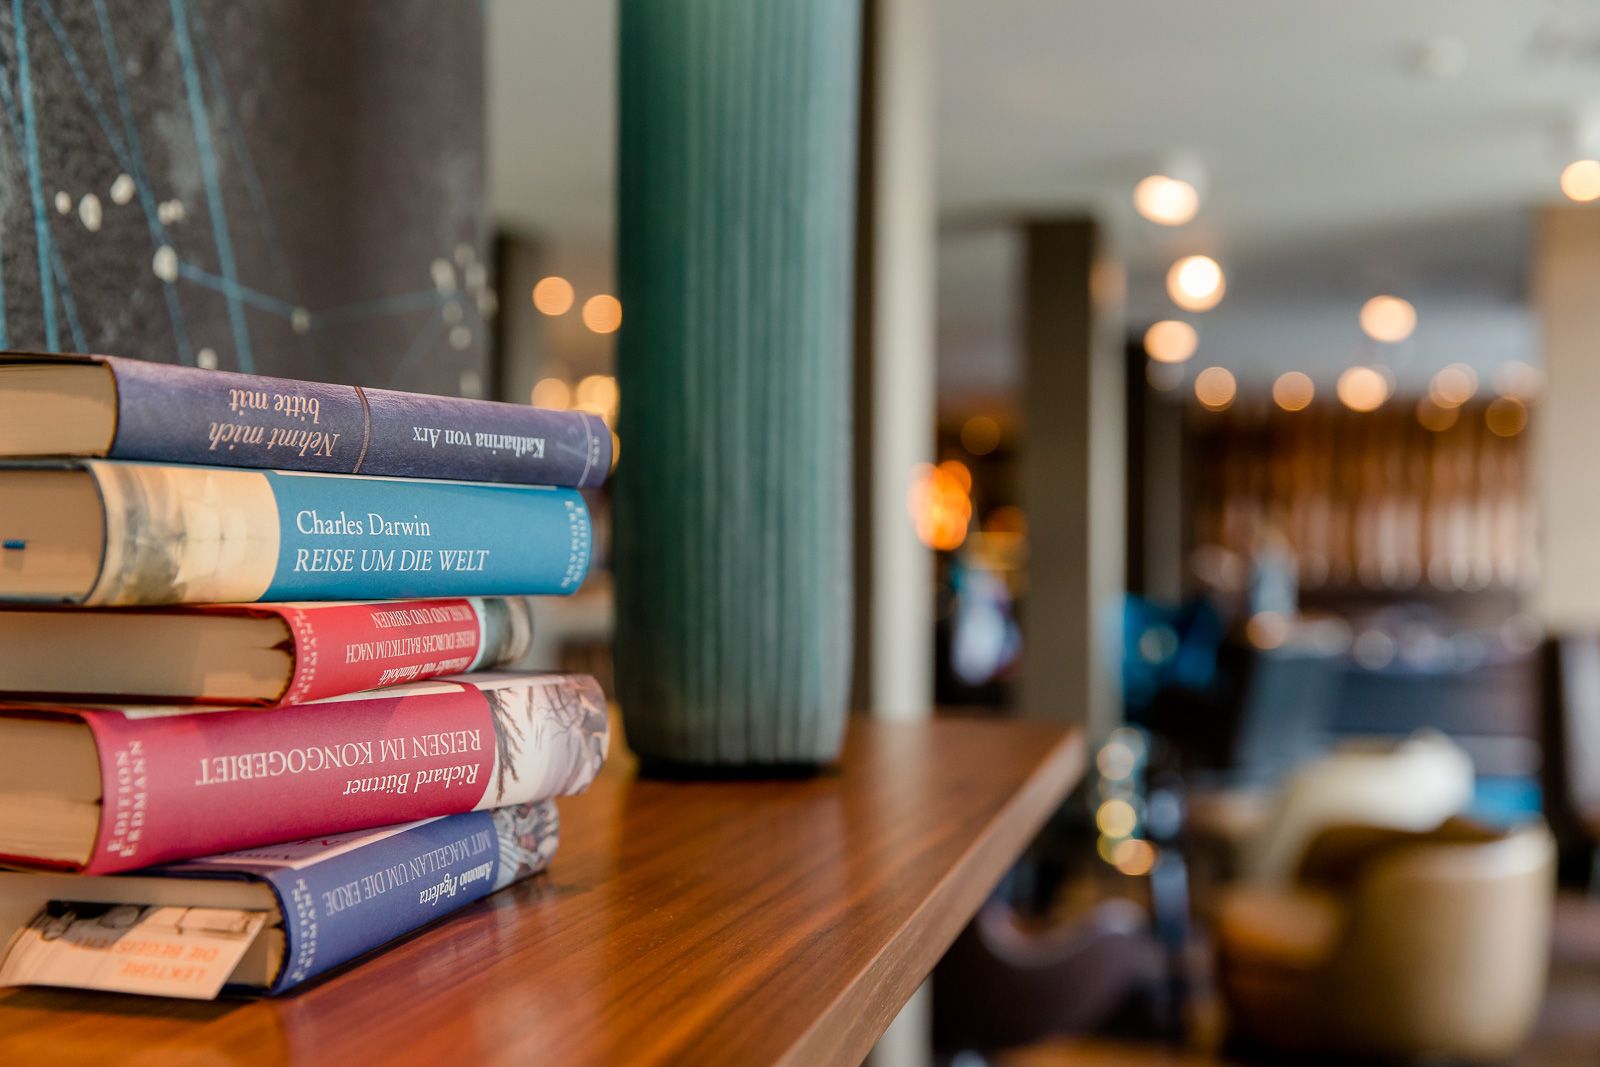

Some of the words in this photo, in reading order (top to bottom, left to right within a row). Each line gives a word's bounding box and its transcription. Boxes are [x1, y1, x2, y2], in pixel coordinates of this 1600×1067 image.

[229, 389, 269, 416] mit
[273, 394, 320, 425] bitte
[208, 422, 264, 450] mich
[267, 427, 341, 457] Nehmt
[413, 426, 441, 448] Arx
[444, 428, 472, 446] von
[475, 432, 546, 459] Katharina
[296, 510, 364, 536] Charles
[368, 514, 431, 537] Darwin
[293, 548, 356, 572] REISE
[360, 549, 396, 572] UM
[399, 549, 433, 571] DIE
[438, 549, 490, 571] WELT
[370, 609, 412, 628] SIBIRIEN
[410, 608, 432, 625] UND
[345, 642, 375, 664] NACH
[375, 637, 421, 660] BALTIKUM
[423, 632, 455, 653] DURCHS
[378, 664, 423, 686] Humboldt
[379, 737, 407, 762] IM
[412, 729, 481, 759] REISEN
[195, 741, 374, 786] KONGOGEBIET
[342, 773, 410, 796] Büttner
[414, 763, 480, 793] Richard
[106, 750, 131, 852] EDITION
[119, 740, 146, 858] ERDMANN
[468, 830, 491, 857] MIT
[409, 837, 469, 880] MAGELLAN
[361, 870, 386, 900] DIE
[385, 863, 410, 891] UM
[419, 872, 458, 906] Pigafetta
[321, 881, 362, 916] ERDE
